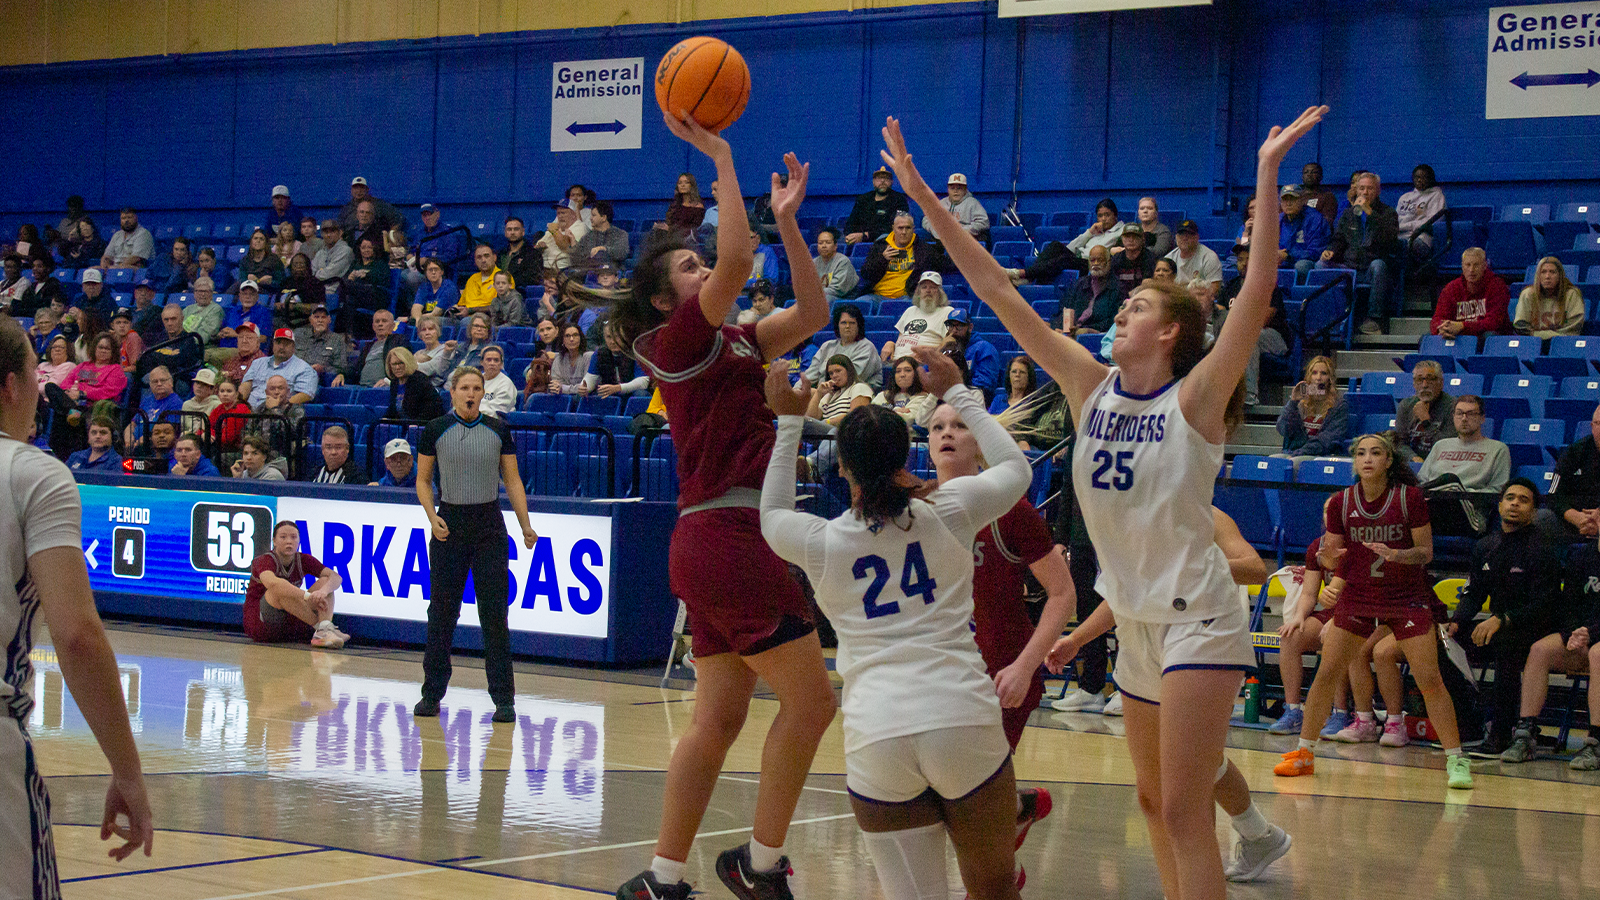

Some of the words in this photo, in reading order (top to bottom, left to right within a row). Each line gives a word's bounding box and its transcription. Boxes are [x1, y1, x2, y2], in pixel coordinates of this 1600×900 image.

[1492, 30, 1600, 53] Admissi
[557, 63, 639, 83] General
[657, 43, 687, 86] NCAA
[554, 83, 641, 99] Admission
[133, 460, 145, 470] POSS
[1437, 450, 1486, 462] REDDIES
[1091, 449, 1134, 491] 25
[109, 505, 150, 525] PERIOD
[207, 510, 255, 569] 53
[1350, 524, 1404, 543] REDDIES
[122, 539, 135, 565] 4
[294, 520, 603, 615] RKAAS
[1370, 554, 1385, 578] 2
[206, 576, 250, 594] REDDIES
[851, 540, 937, 620] 24
[1251, 634, 1281, 646] LERIDER
[1416, 720, 1427, 736] G
